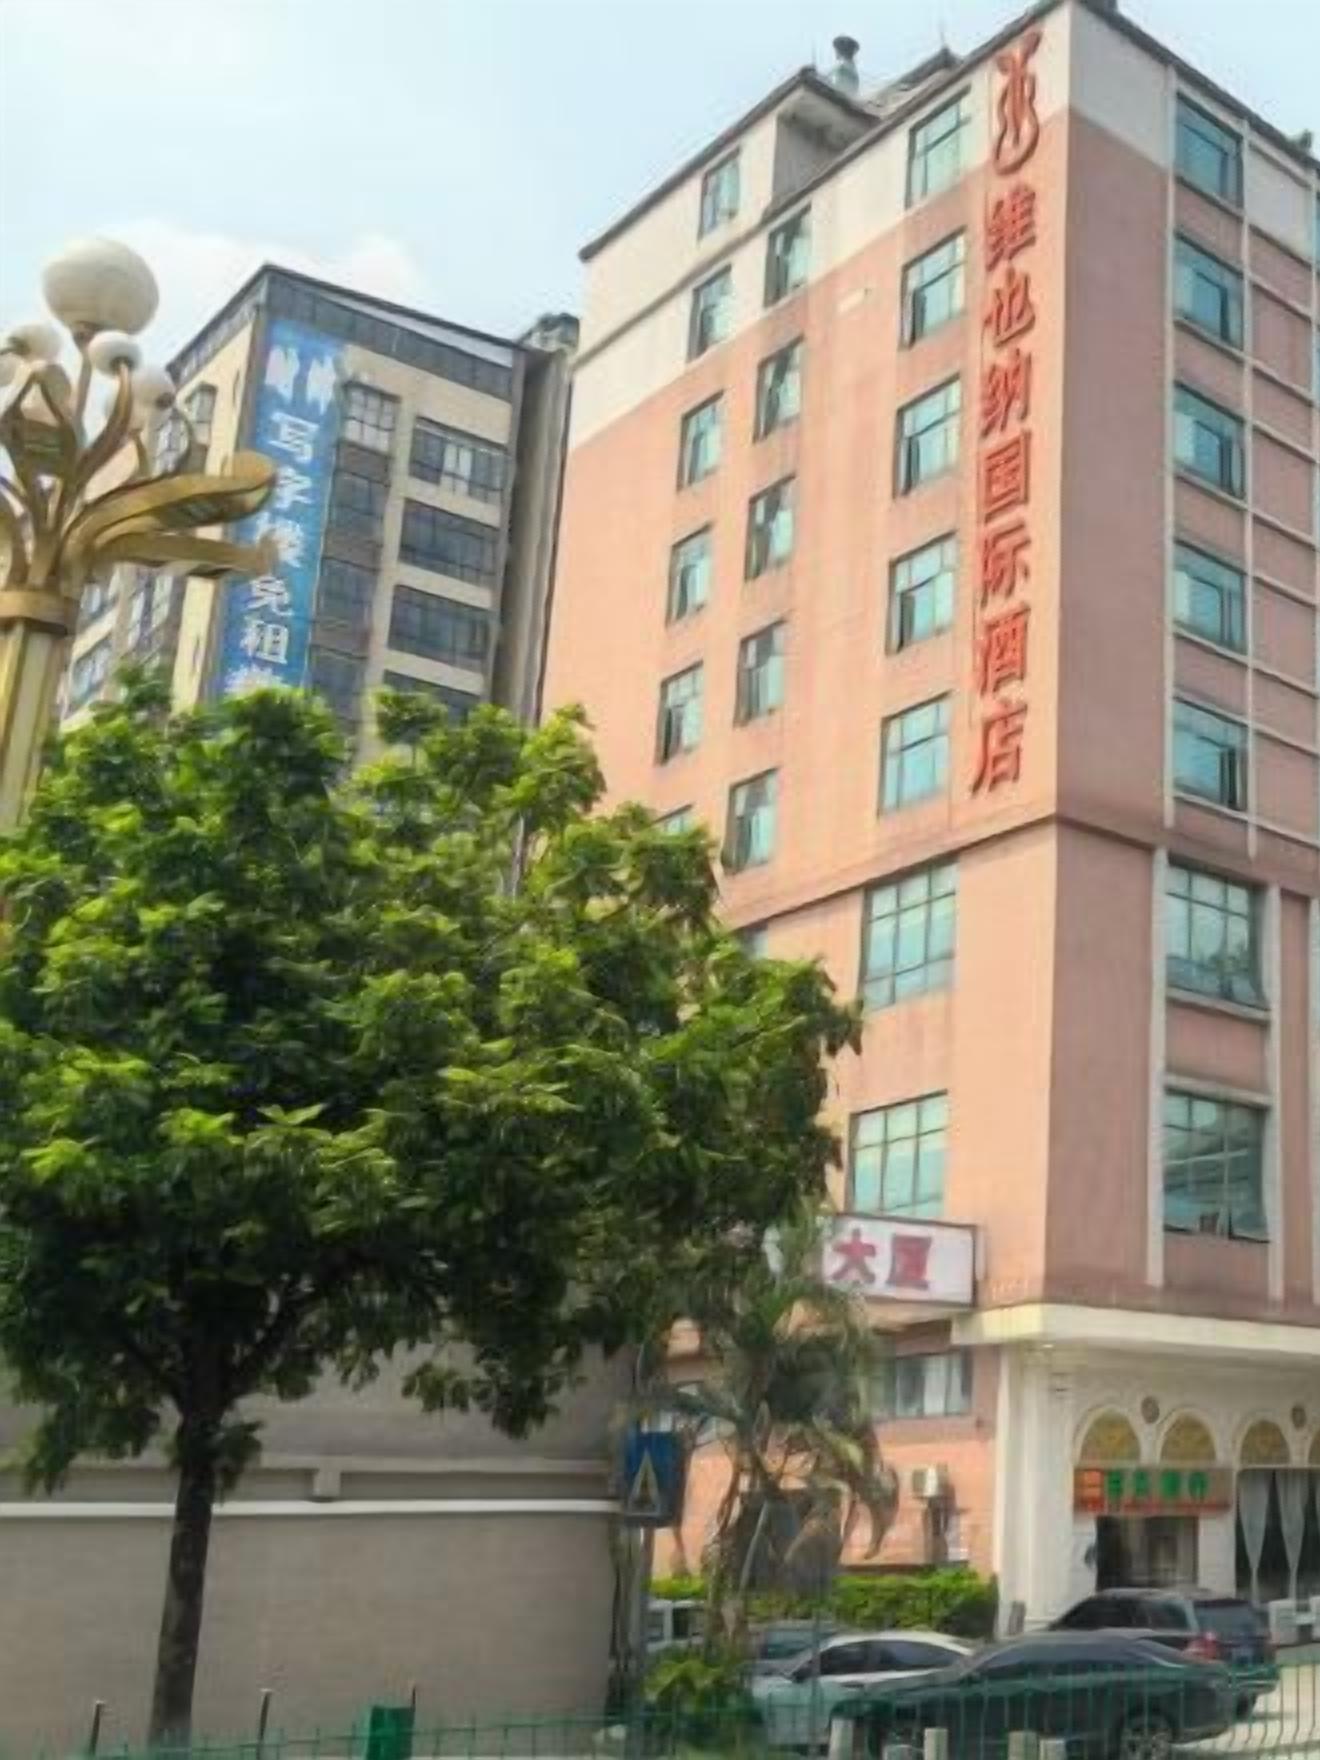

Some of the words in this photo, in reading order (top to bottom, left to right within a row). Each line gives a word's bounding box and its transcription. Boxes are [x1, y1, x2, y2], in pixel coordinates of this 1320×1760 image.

[971, 184, 1036, 794] 维也纳国际酒店
